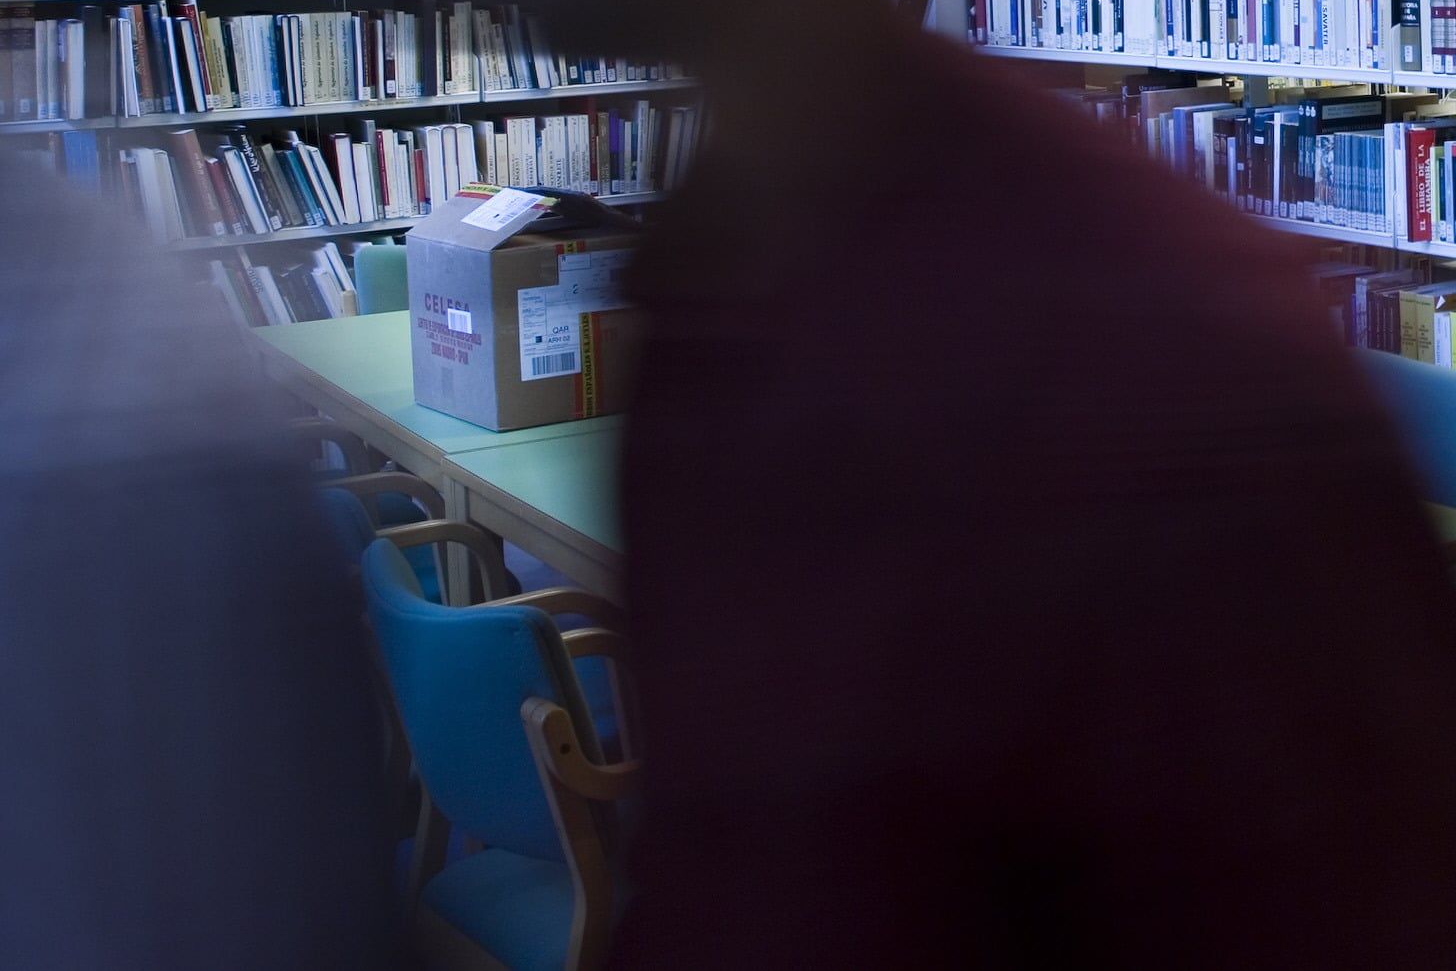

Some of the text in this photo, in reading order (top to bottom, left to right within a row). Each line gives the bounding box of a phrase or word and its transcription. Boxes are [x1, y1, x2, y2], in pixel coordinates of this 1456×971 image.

[1418, 144, 1425, 157] LA
[1418, 163, 1425, 177] DE
[1419, 218, 1426, 231] EL
